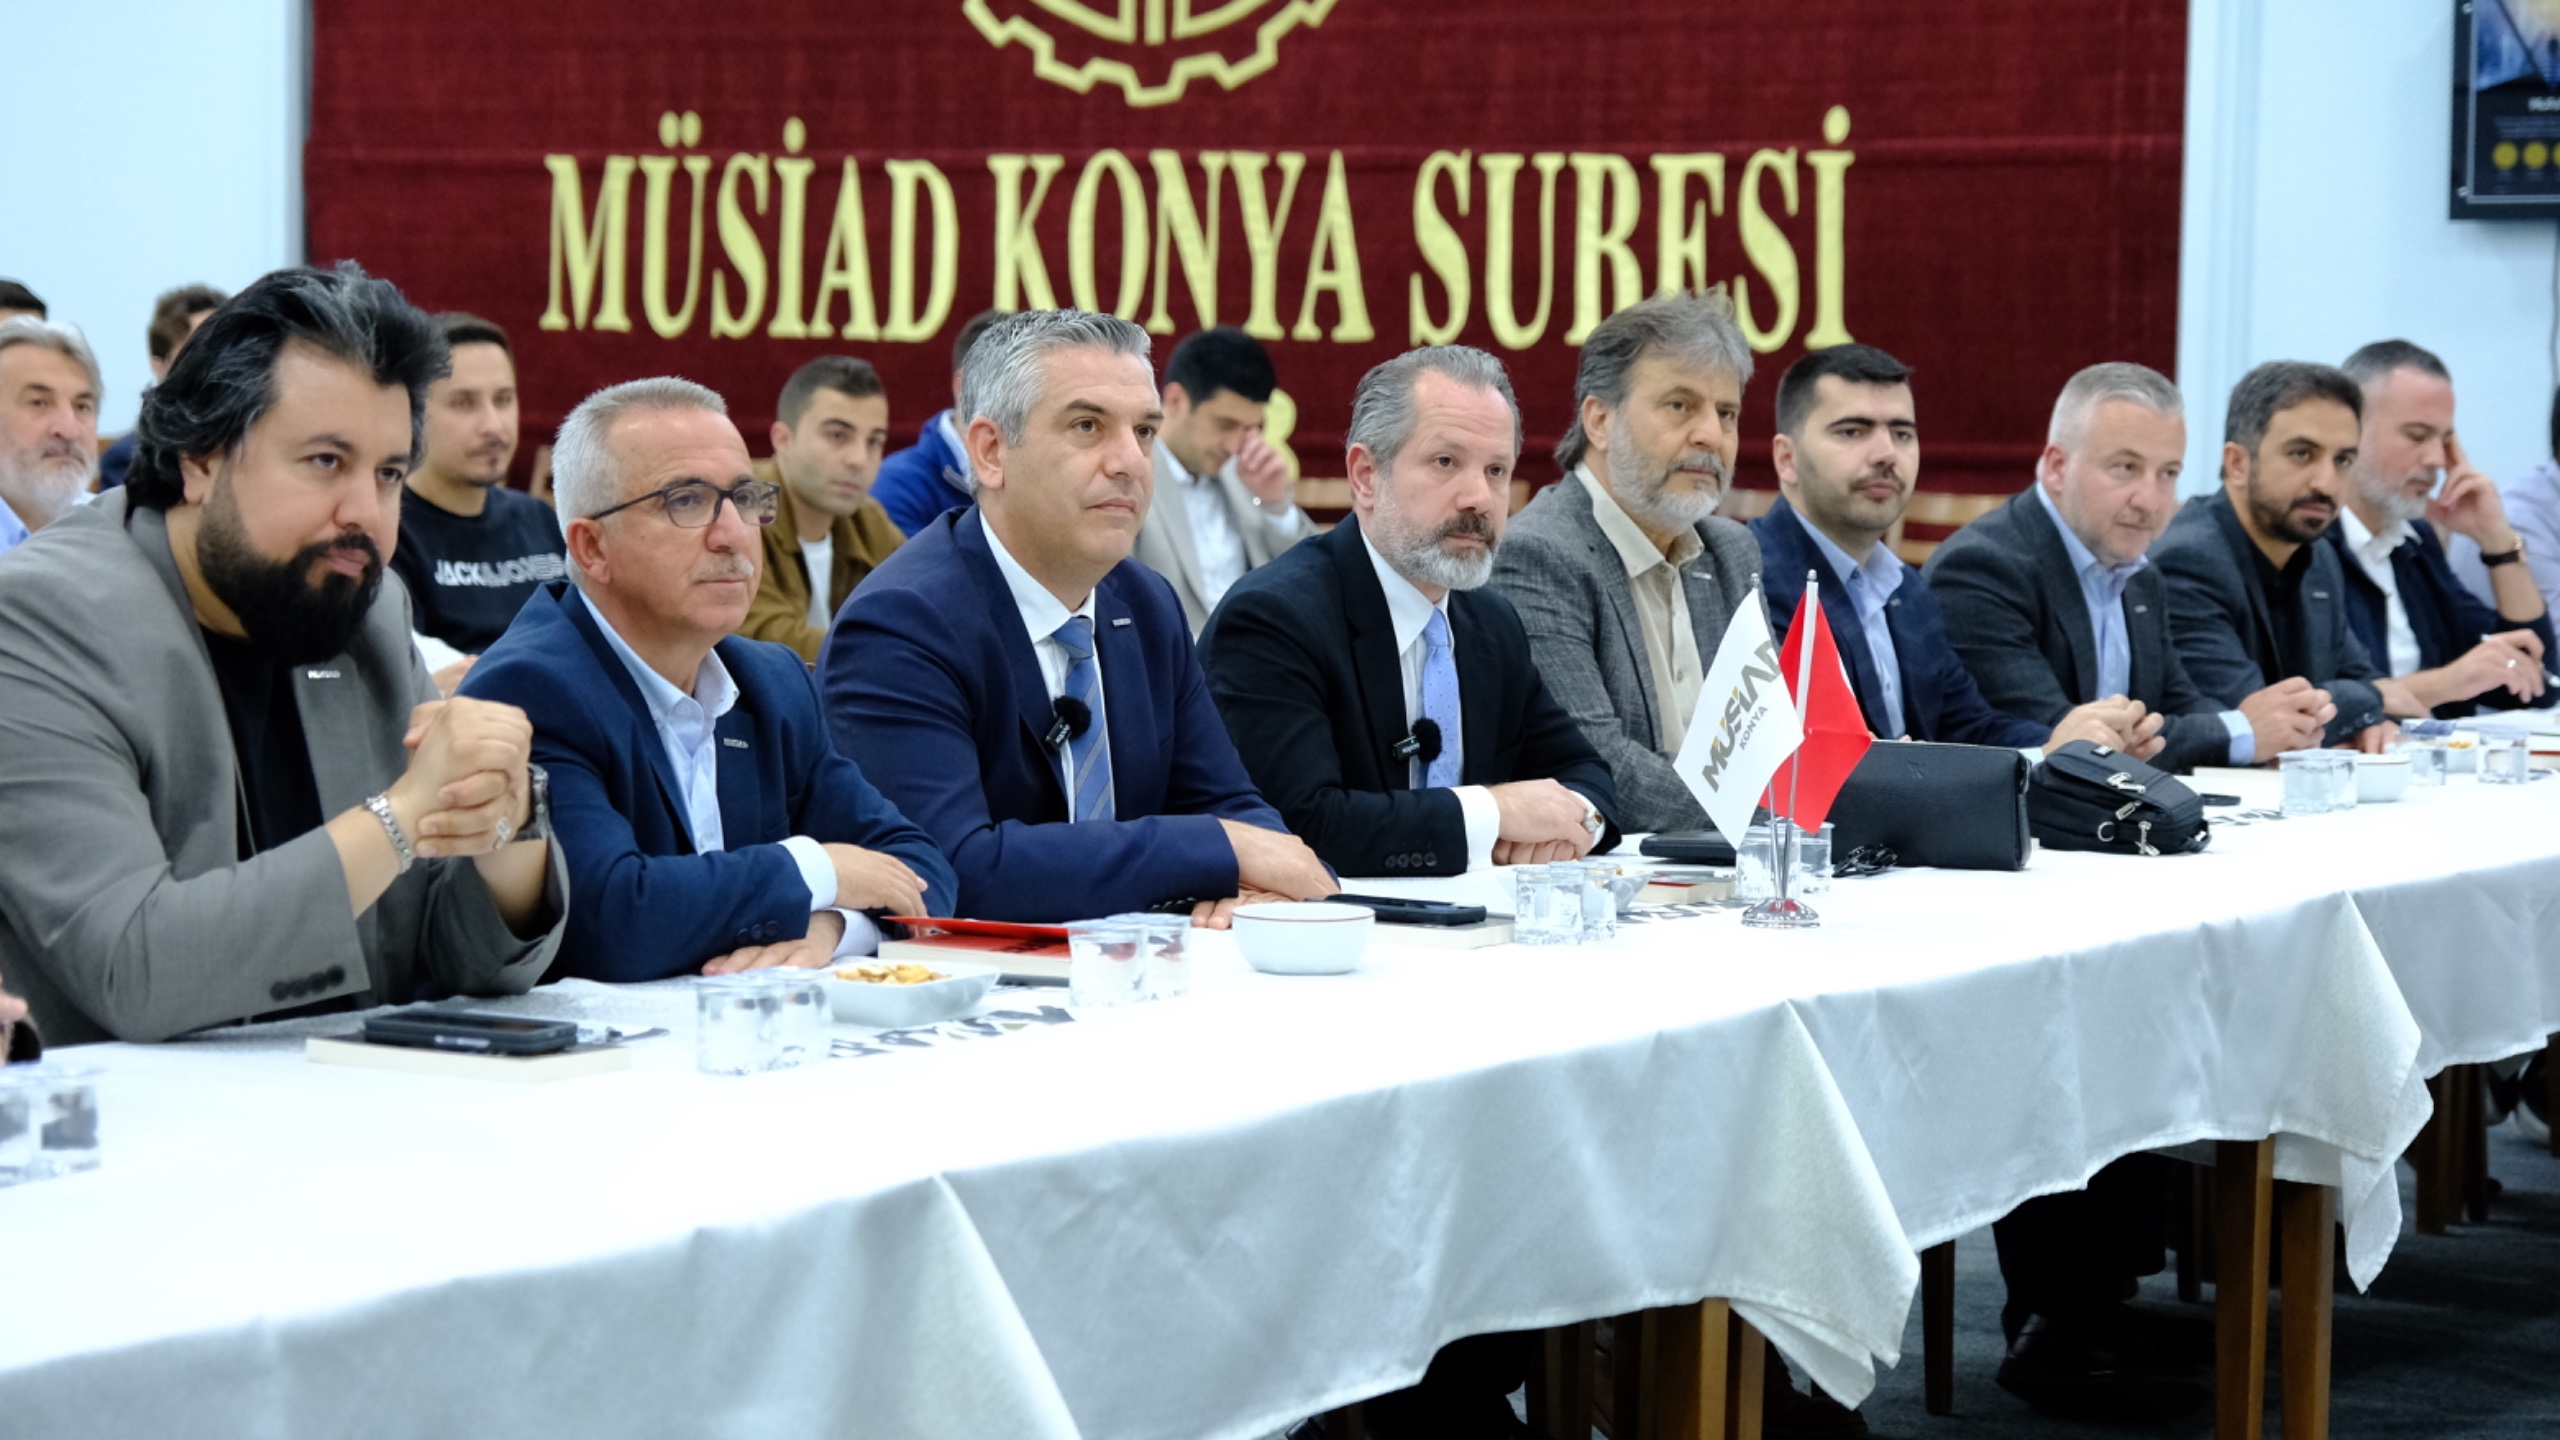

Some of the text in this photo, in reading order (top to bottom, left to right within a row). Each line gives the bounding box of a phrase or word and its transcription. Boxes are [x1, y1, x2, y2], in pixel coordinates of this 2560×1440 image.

[539, 110, 959, 342] MÜSİAD
[986, 149, 1375, 342] KONYA
[1739, 705, 1768, 750] KONYA
